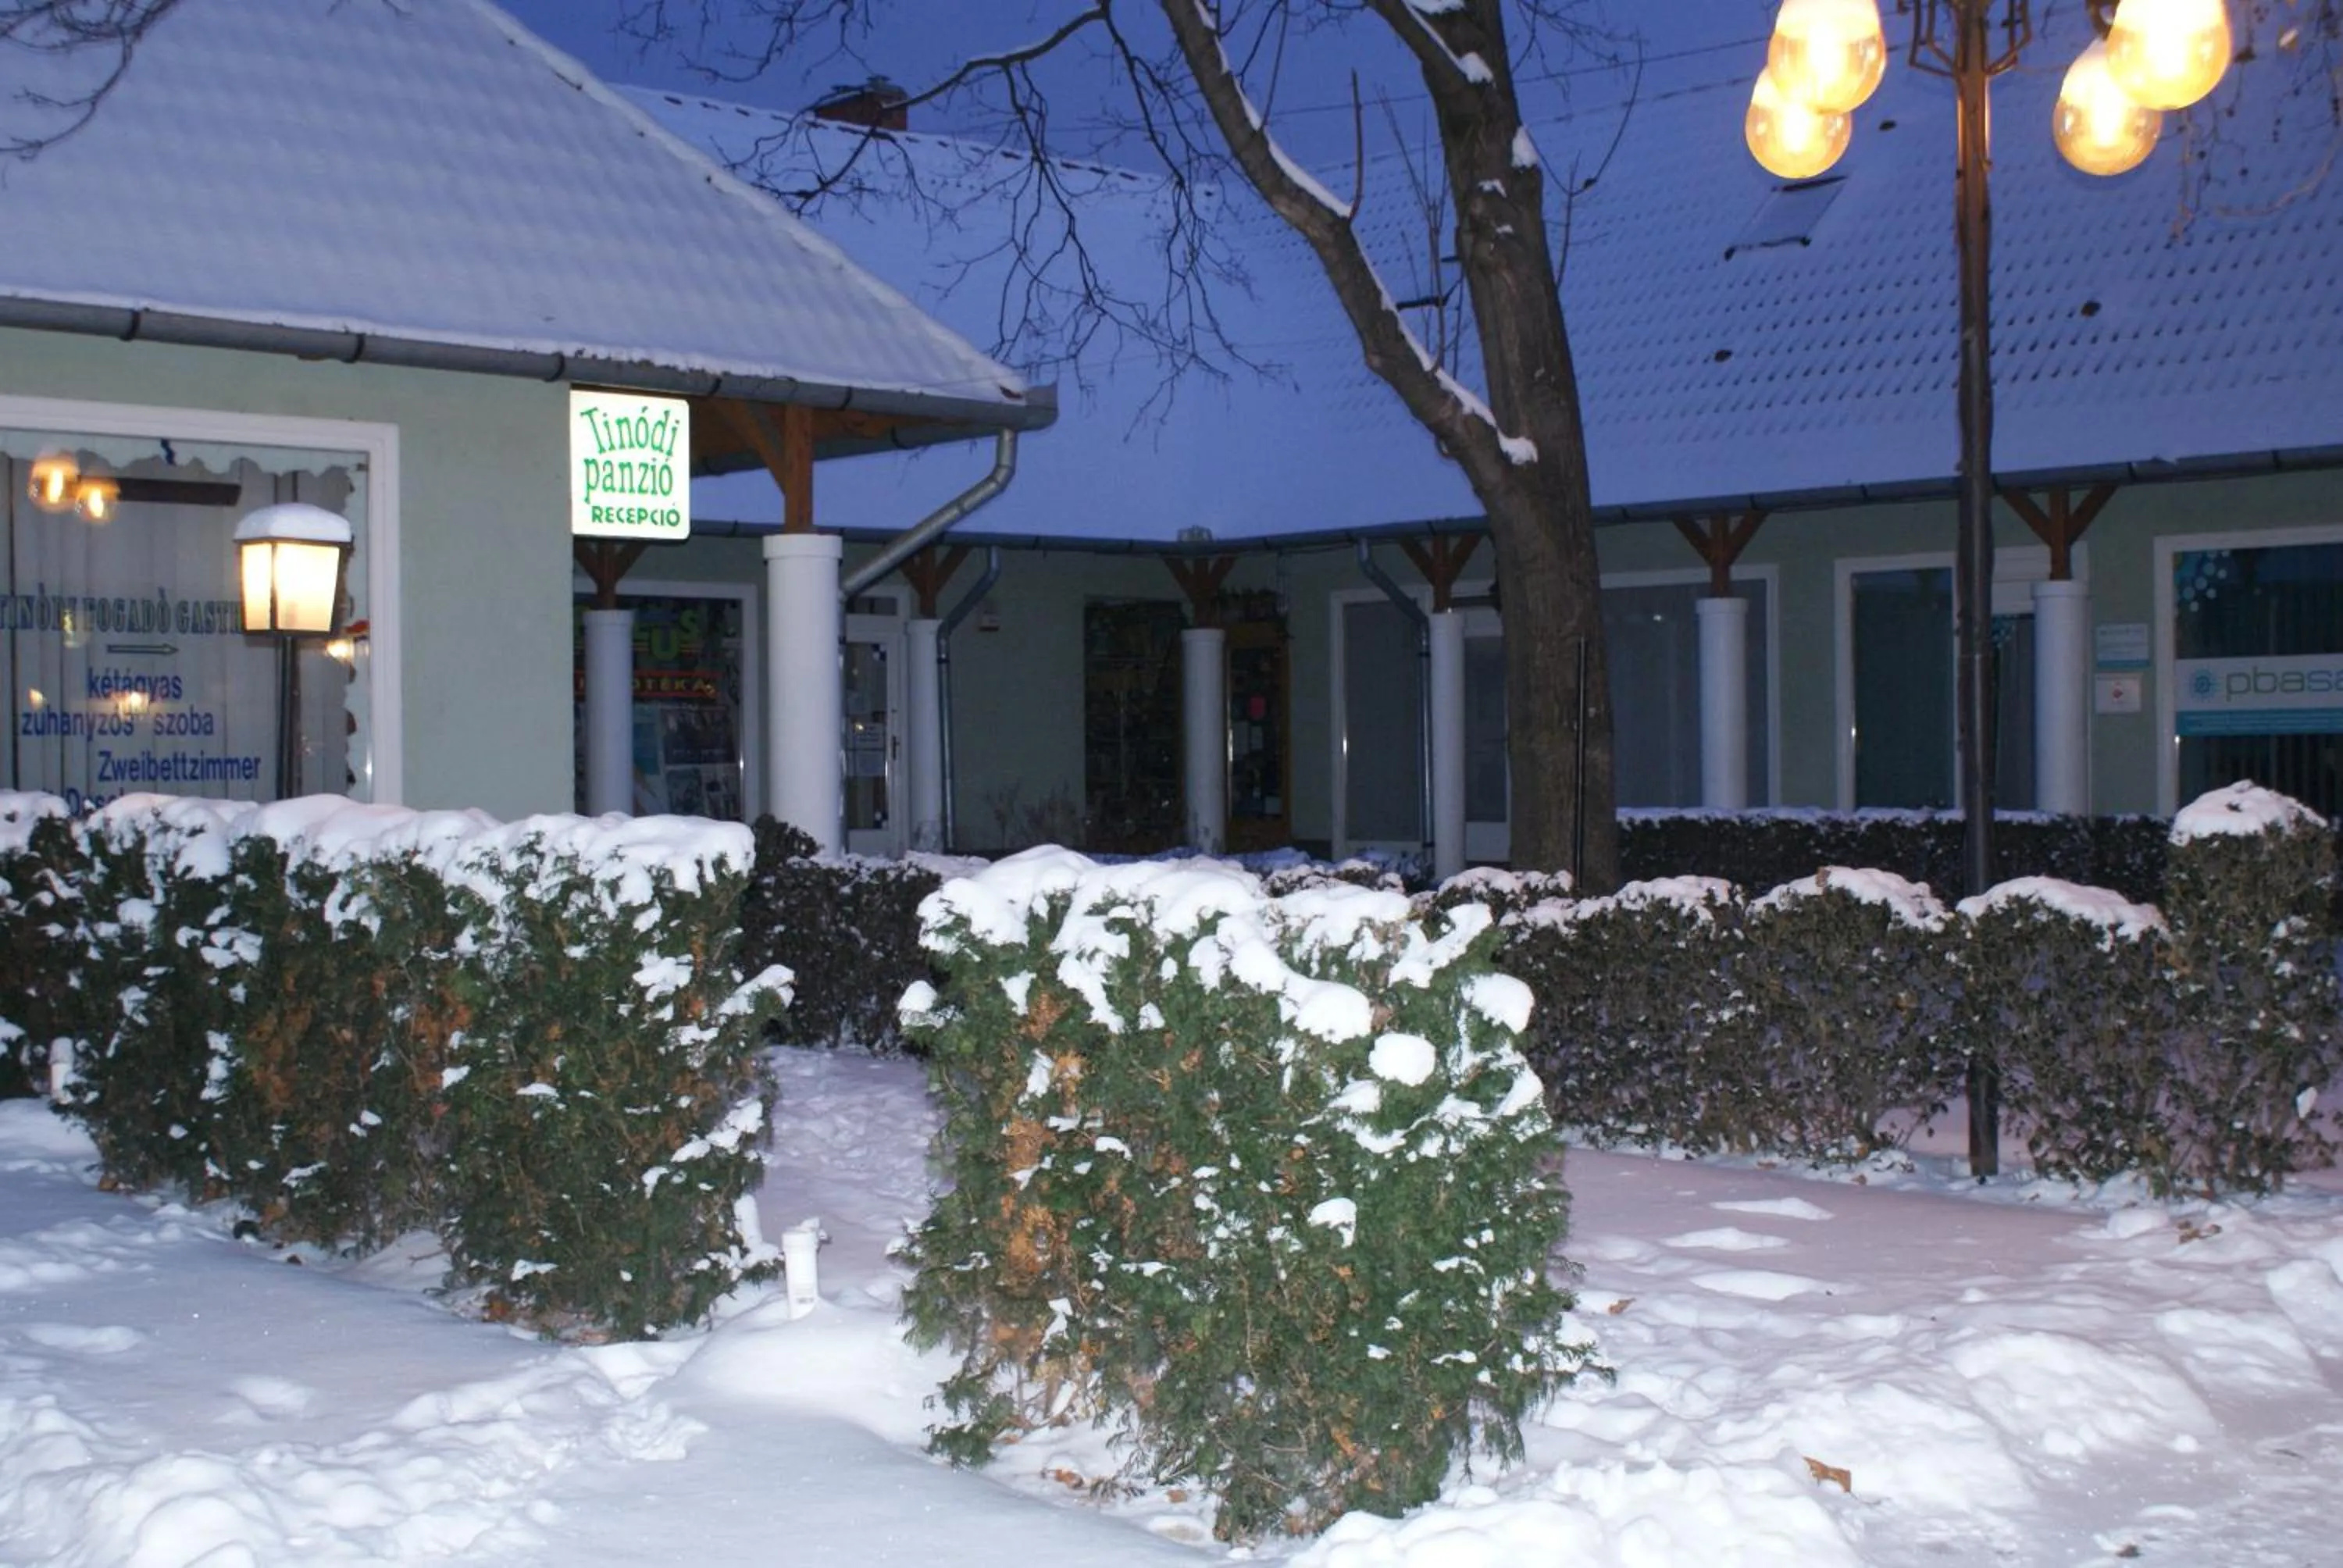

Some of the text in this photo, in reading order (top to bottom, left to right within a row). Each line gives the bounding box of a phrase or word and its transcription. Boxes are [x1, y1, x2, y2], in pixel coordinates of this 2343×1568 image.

[580, 405, 679, 456] Tinódi
[583, 456, 673, 504] panzió
[591, 501, 681, 527] RECEPCIÓ
[87, 667, 183, 707] kétágyas
[152, 704, 214, 736] szoba
[98, 750, 261, 782] Zweibettzimmer
